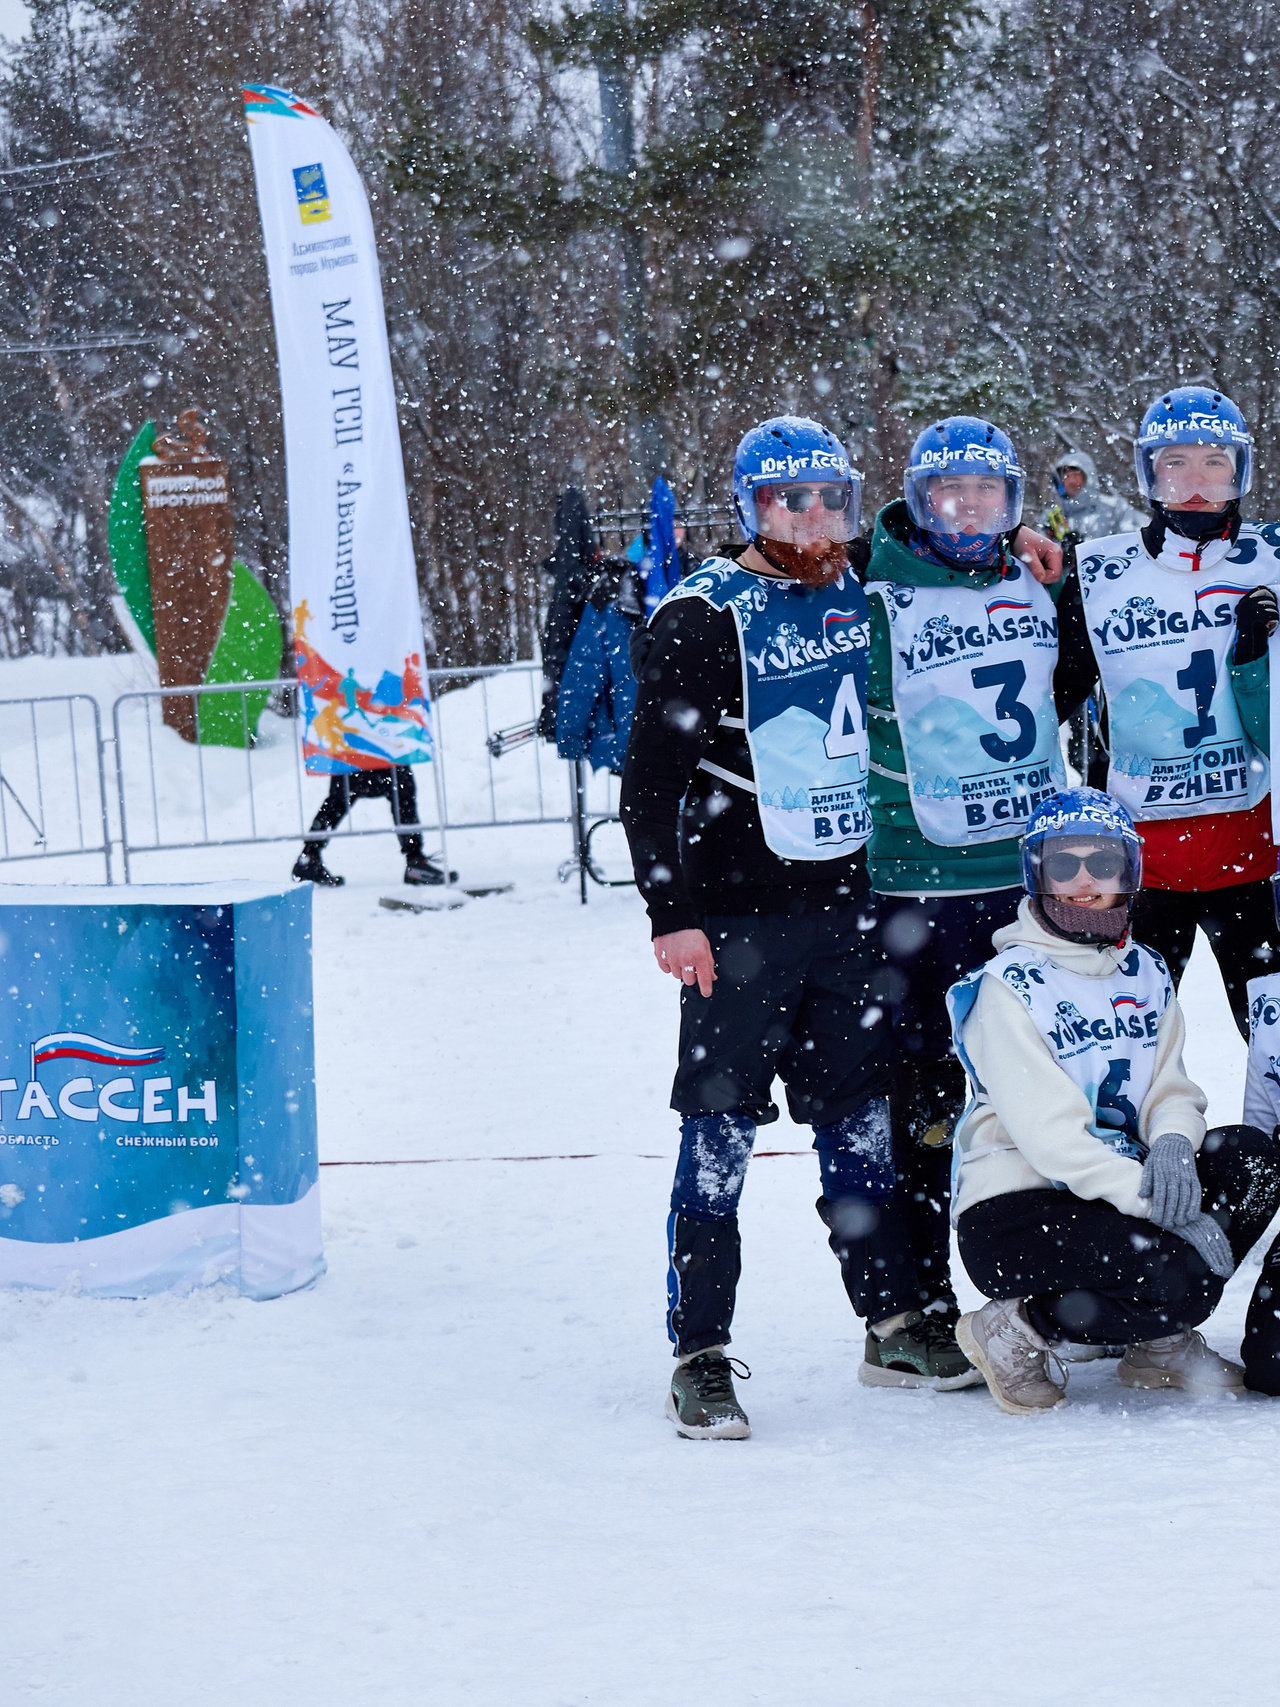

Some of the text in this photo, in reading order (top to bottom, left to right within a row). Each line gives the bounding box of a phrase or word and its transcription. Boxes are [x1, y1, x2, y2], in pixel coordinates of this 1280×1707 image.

[322, 296, 359, 371] МАУ
[331, 384, 363, 449] ГСЦ
[1177, 649, 1217, 749] 1
[971, 659, 1037, 763] 3
[823, 673, 868, 773] 4
[1192, 746, 1246, 771] ТОЛК
[1014, 766, 1052, 788] ТОЛК
[1151, 775, 1171, 783] КТО
[1152, 765, 1173, 775] ДЛЯ
[962, 777, 1010, 793] ДЛЯ ТЕХ,
[963, 787, 1011, 801] КТО ЗНАЕТ
[1144, 767, 1247, 802] В СНЕГЕ
[811, 791, 854, 805] ДЛЯ ТЕХ,
[812, 802, 854, 814] КТО ЗНАЕТ
[965, 803, 987, 826] В
[815, 817, 833, 839] В
[116, 1134, 187, 1147] СНЕЖНЫЙ
[190, 1134, 219, 1147] БОЙ
